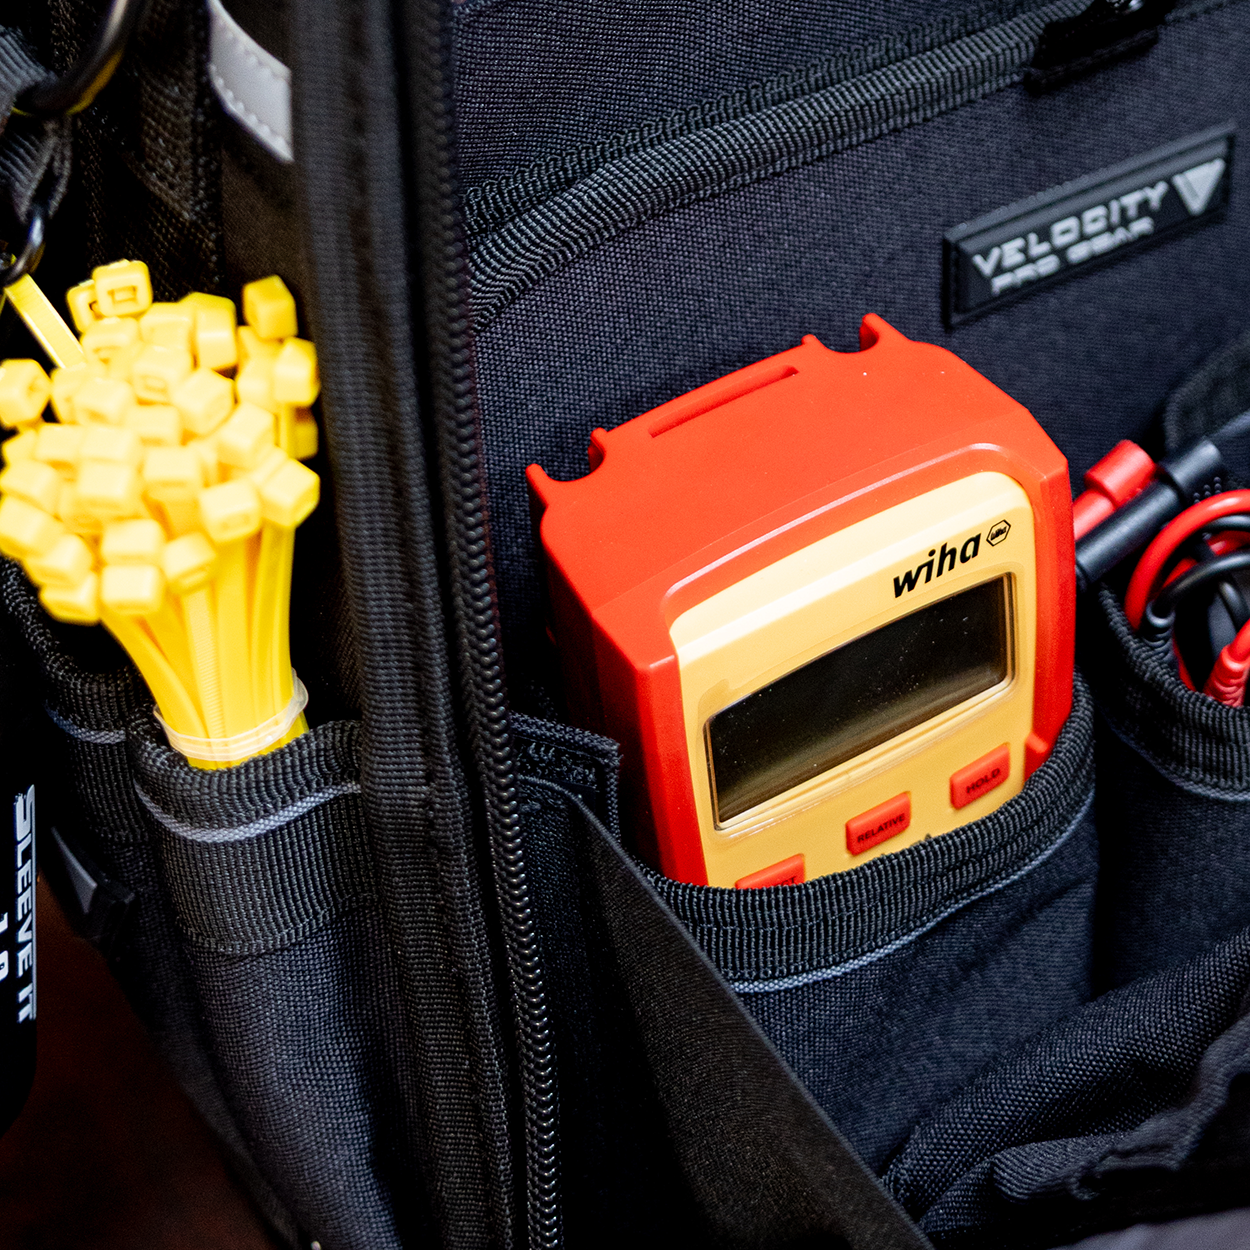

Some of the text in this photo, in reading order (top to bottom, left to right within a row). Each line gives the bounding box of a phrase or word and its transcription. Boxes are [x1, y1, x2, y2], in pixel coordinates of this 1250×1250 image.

[971, 180, 1169, 278] VELOCITY
[990, 215, 1155, 296] PRO GEAR
[892, 532, 982, 599] wiha
[965, 767, 1001, 794] HOLD
[856, 812, 906, 843] RELATIVE
[13, 784, 37, 980] SLEEVE
